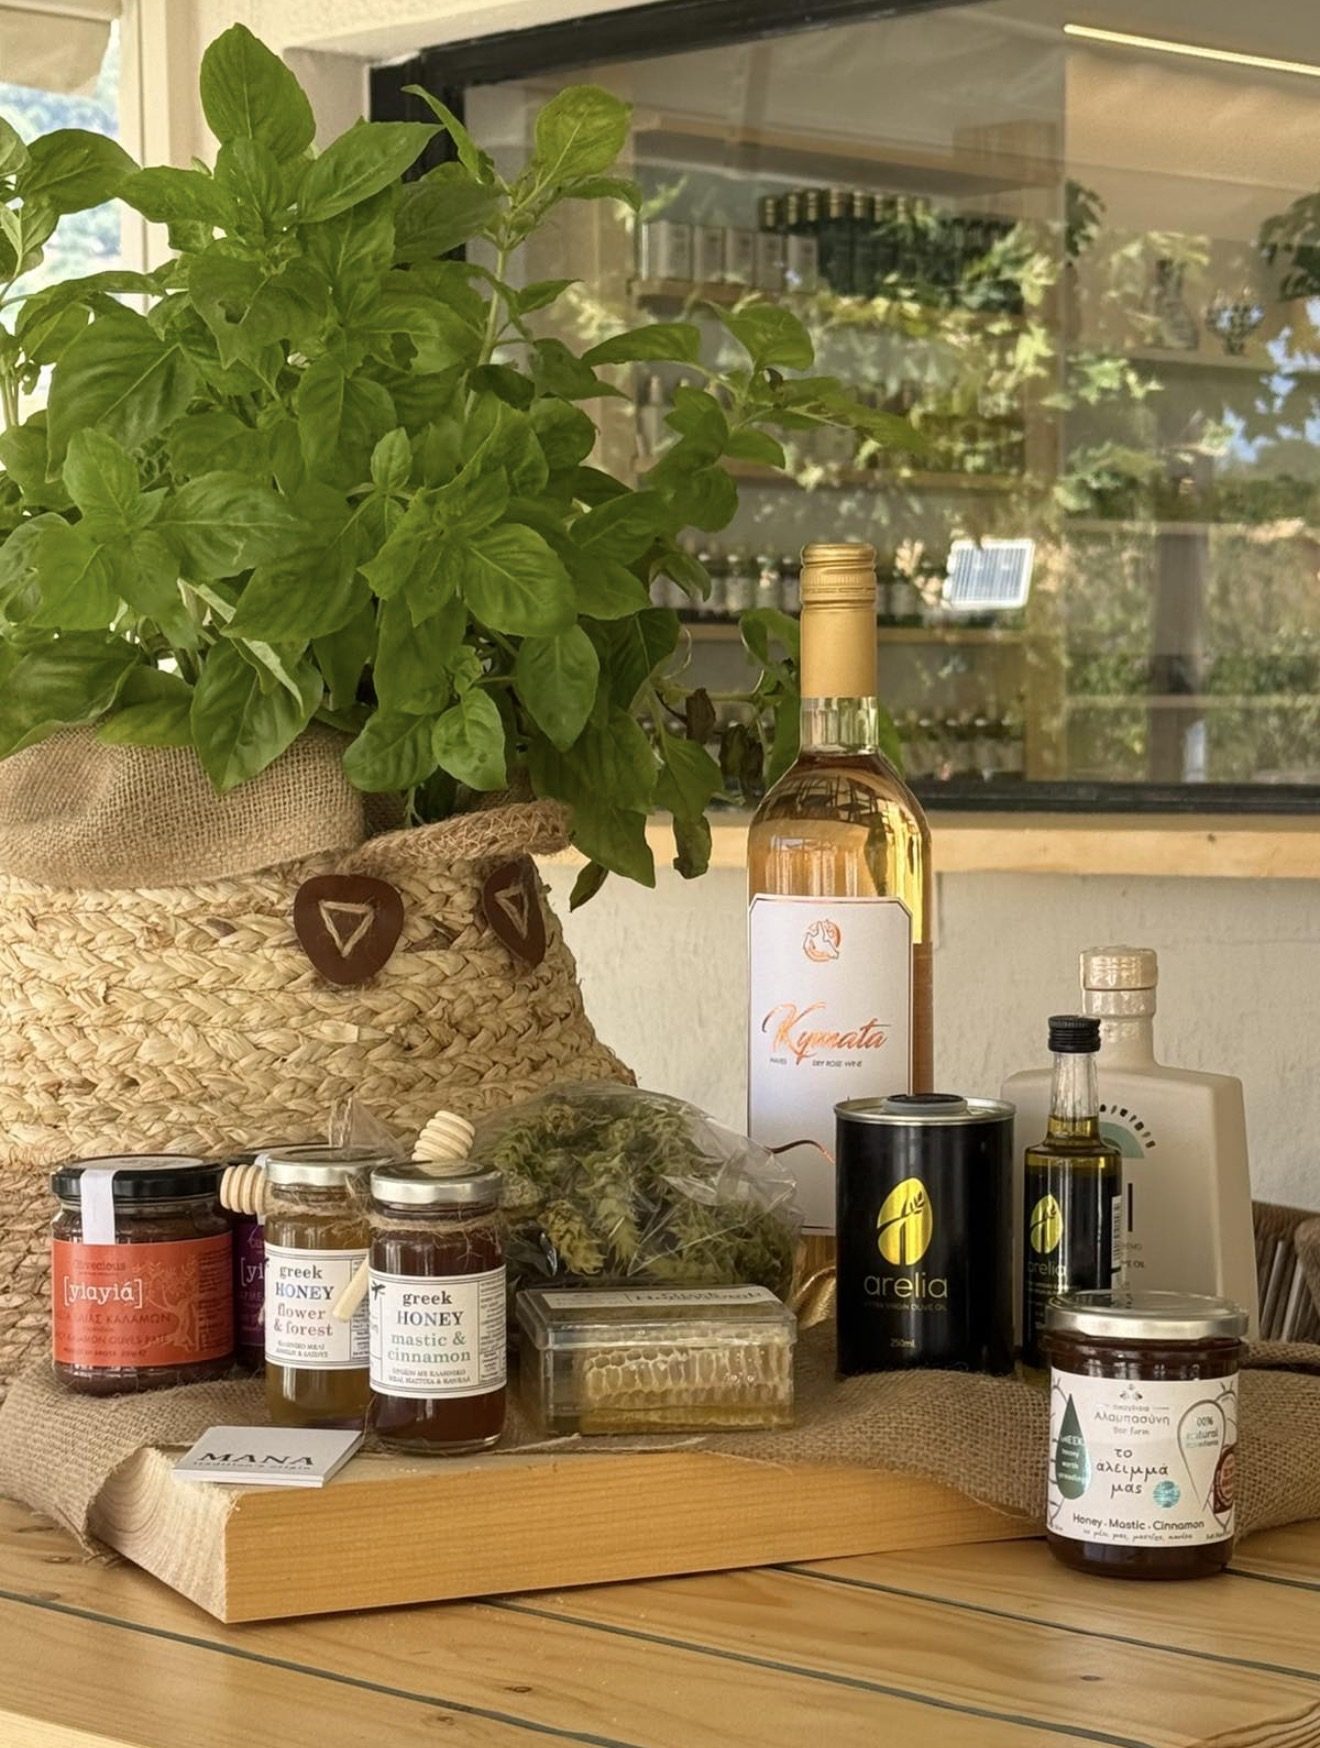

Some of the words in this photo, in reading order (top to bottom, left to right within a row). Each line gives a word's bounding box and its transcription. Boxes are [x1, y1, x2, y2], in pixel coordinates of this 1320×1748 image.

[762, 1002, 891, 1065] Kymata
[279, 1265, 323, 1280] greek
[275, 1282, 334, 1301] HONEY
[864, 1272, 948, 1299] arelia
[402, 1290, 453, 1307] greek
[277, 1303, 326, 1320] flower
[397, 1310, 464, 1327] HONEY
[273, 1320, 286, 1333] &
[286, 1320, 333, 1337] forest
[391, 1333, 447, 1347] mastic
[452, 1332, 467, 1346] &
[387, 1348, 471, 1364] cinnamon
[196, 1452, 313, 1466] MANA
[1114, 1448, 1133, 1458] το
[1110, 1483, 1142, 1499] μας
[1073, 1513, 1102, 1528] Honey
[1109, 1519, 1146, 1530] Mastic
[1152, 1519, 1205, 1532] Cinnamon
